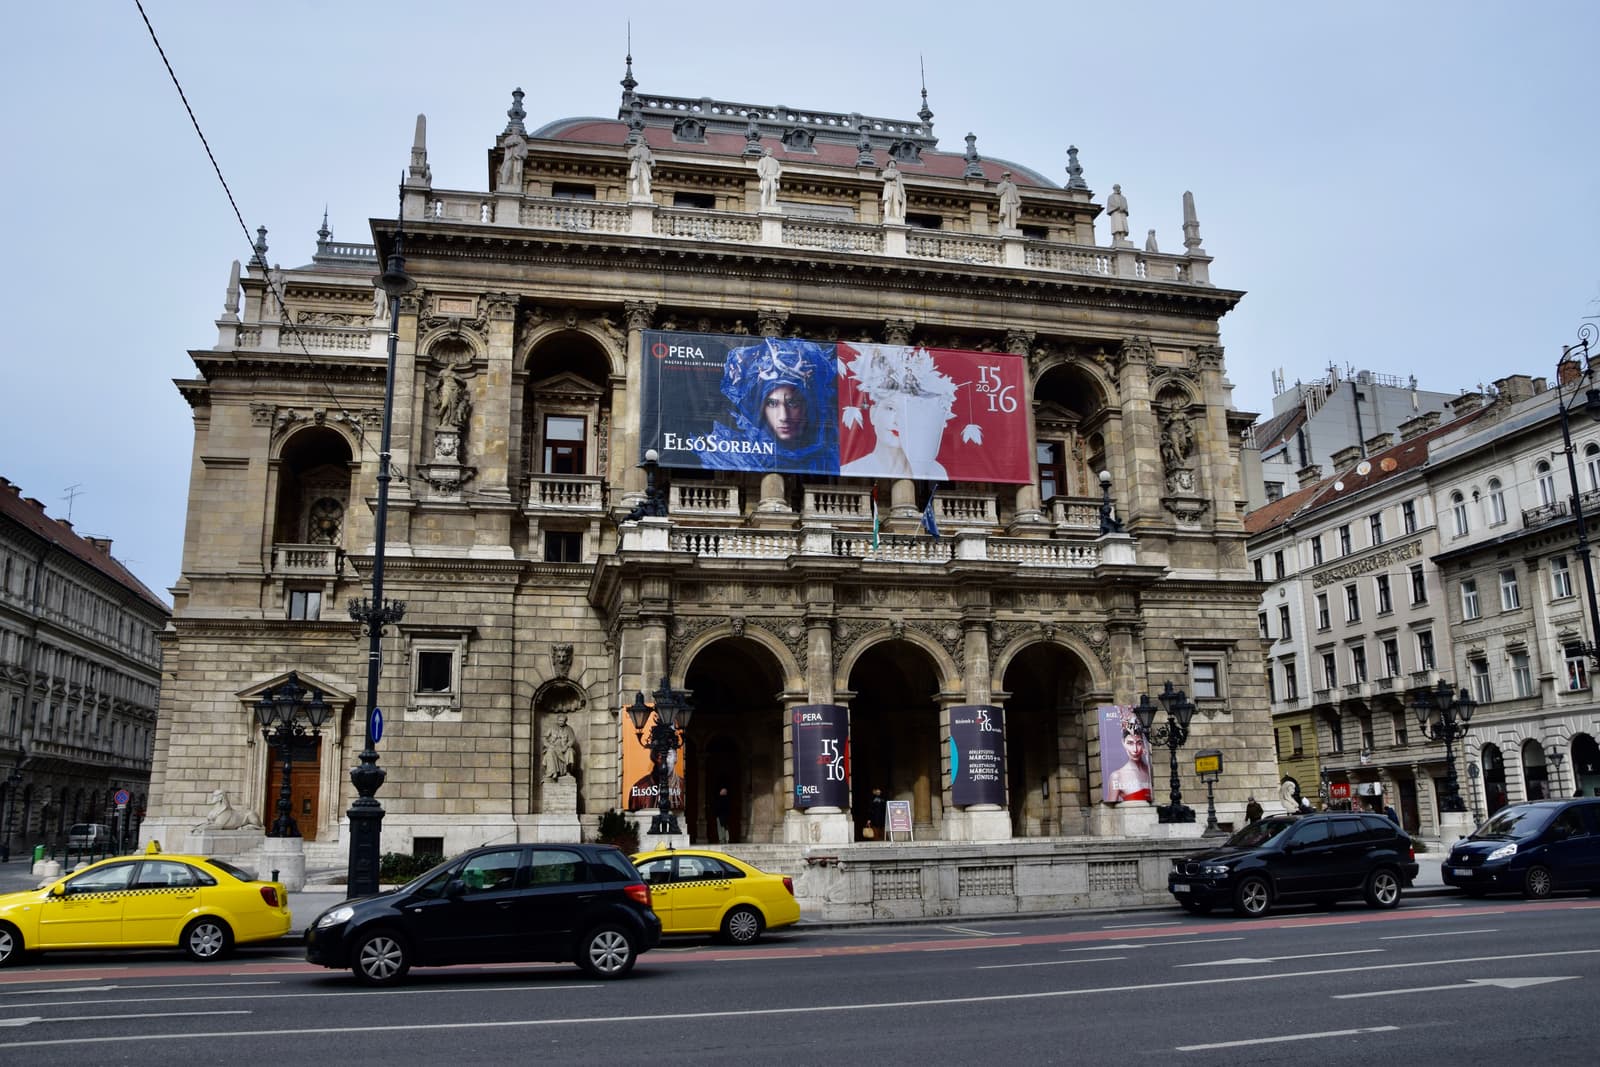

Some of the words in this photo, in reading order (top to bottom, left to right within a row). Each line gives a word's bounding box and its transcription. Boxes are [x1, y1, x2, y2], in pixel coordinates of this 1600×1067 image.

[652, 343, 704, 359] OPERA
[976, 384, 990, 392] 20
[977, 366, 1002, 392] 15
[987, 385, 1017, 413] 16
[794, 713, 822, 723] OPERA
[821, 739, 839, 763] 15
[826, 756, 845, 781] 16
